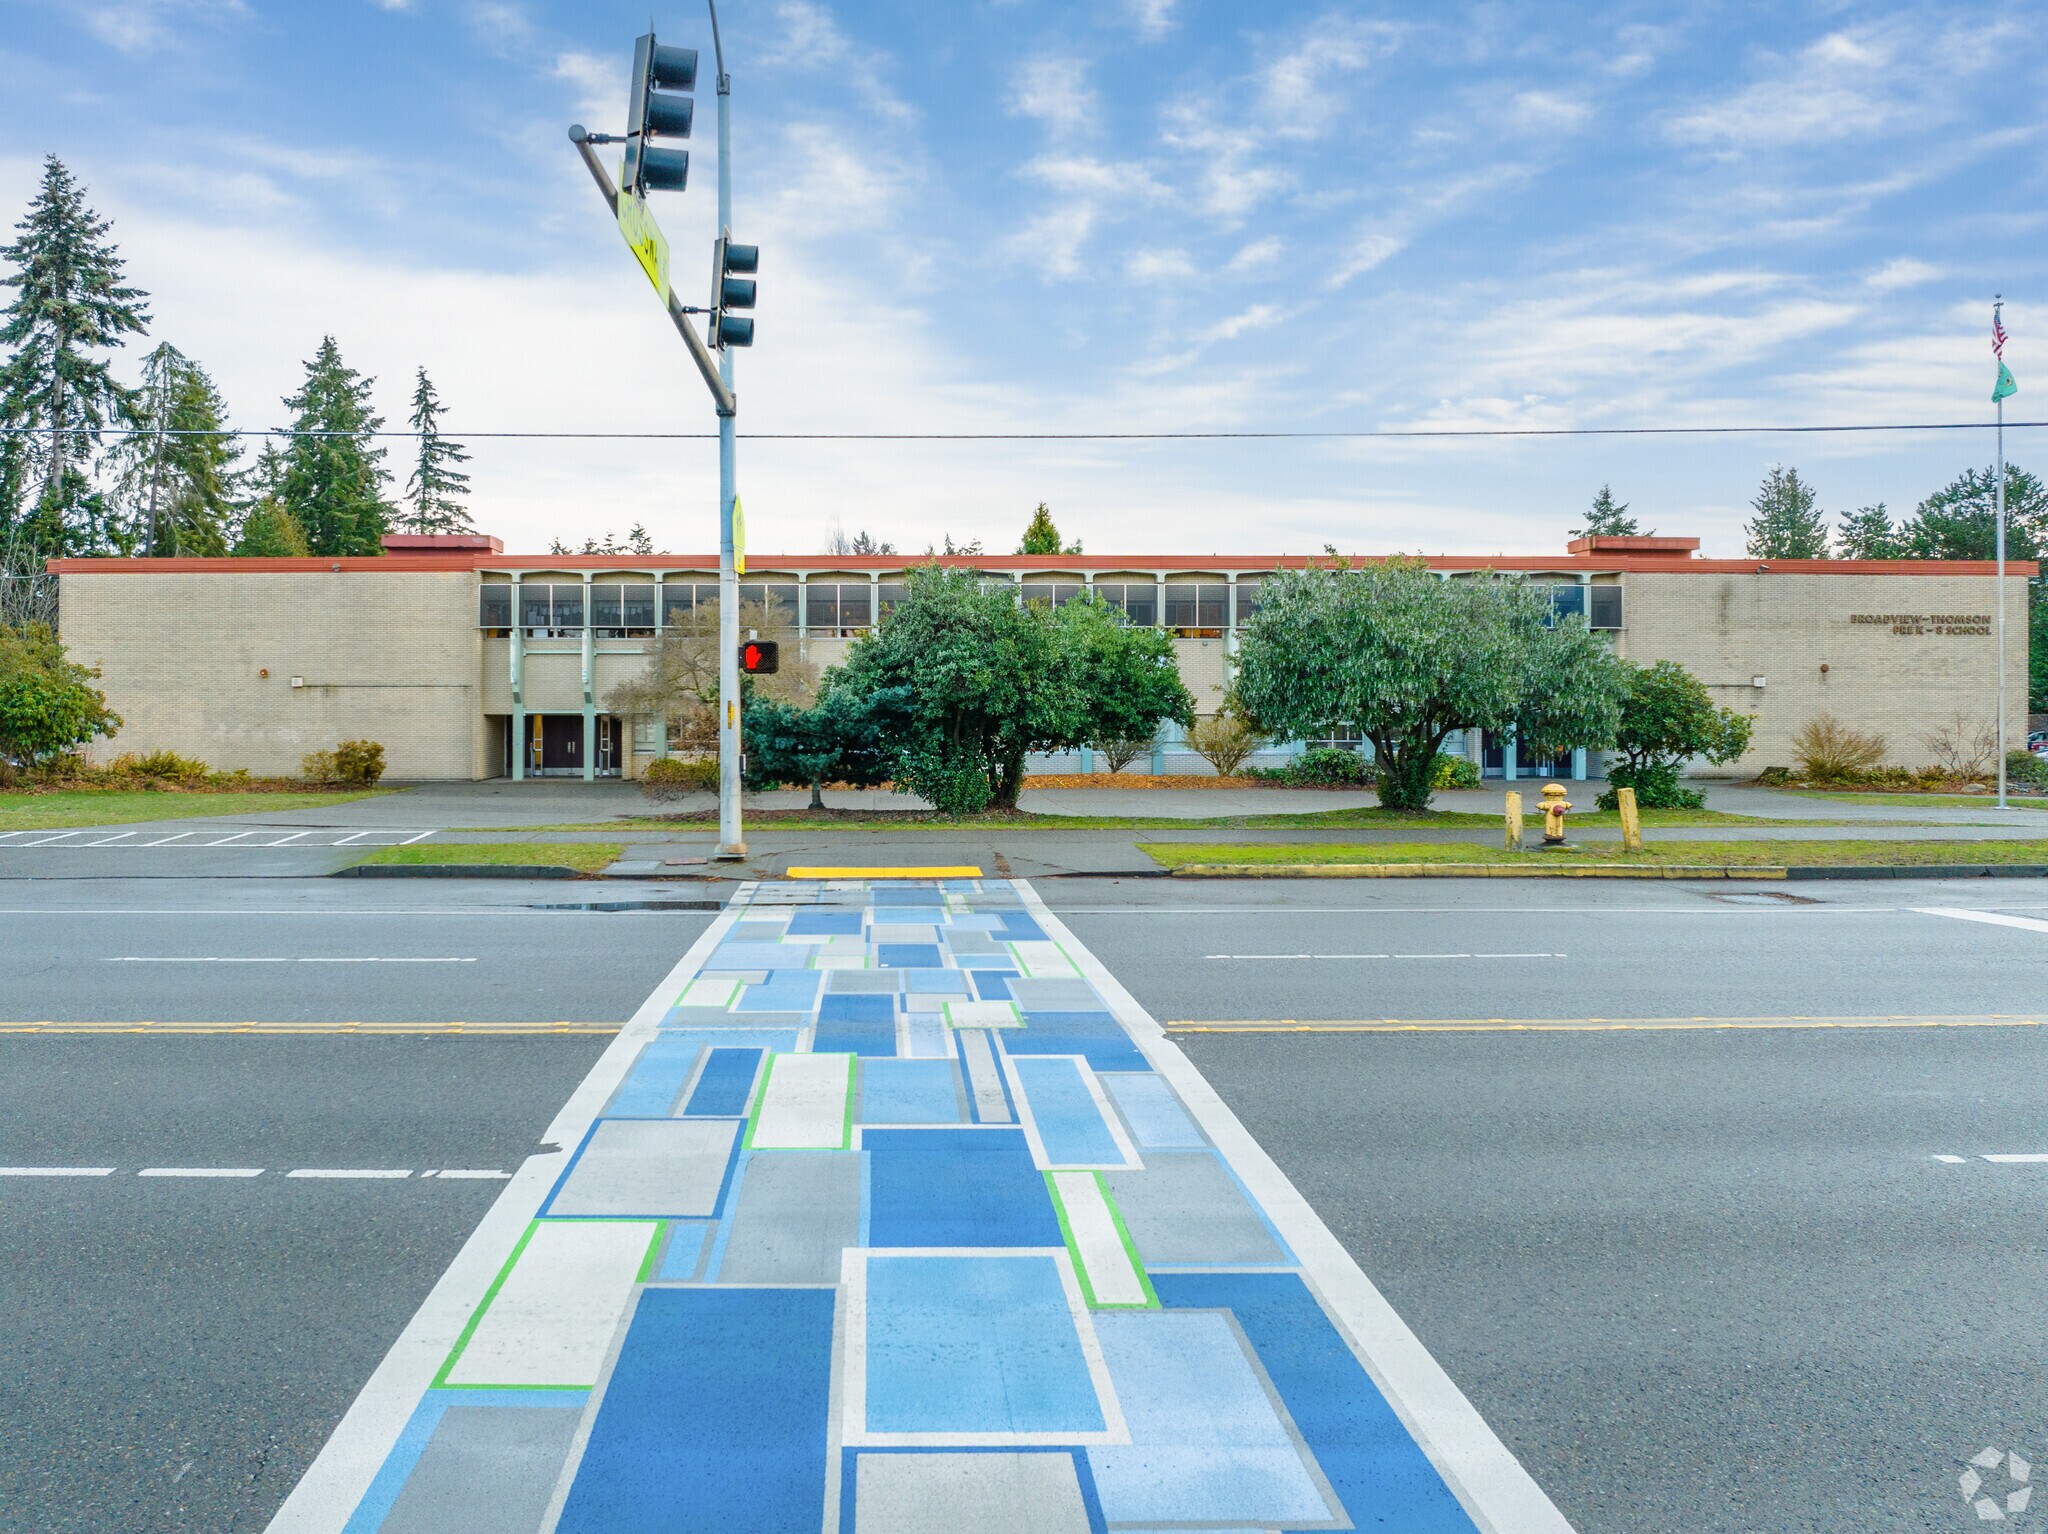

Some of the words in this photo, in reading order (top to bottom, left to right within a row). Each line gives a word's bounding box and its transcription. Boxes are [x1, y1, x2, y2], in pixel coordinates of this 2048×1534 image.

[1893, 625, 1914, 635] PRE
[1916, 625, 1925, 635] K
[1945, 625, 1992, 636] SCHOOL
